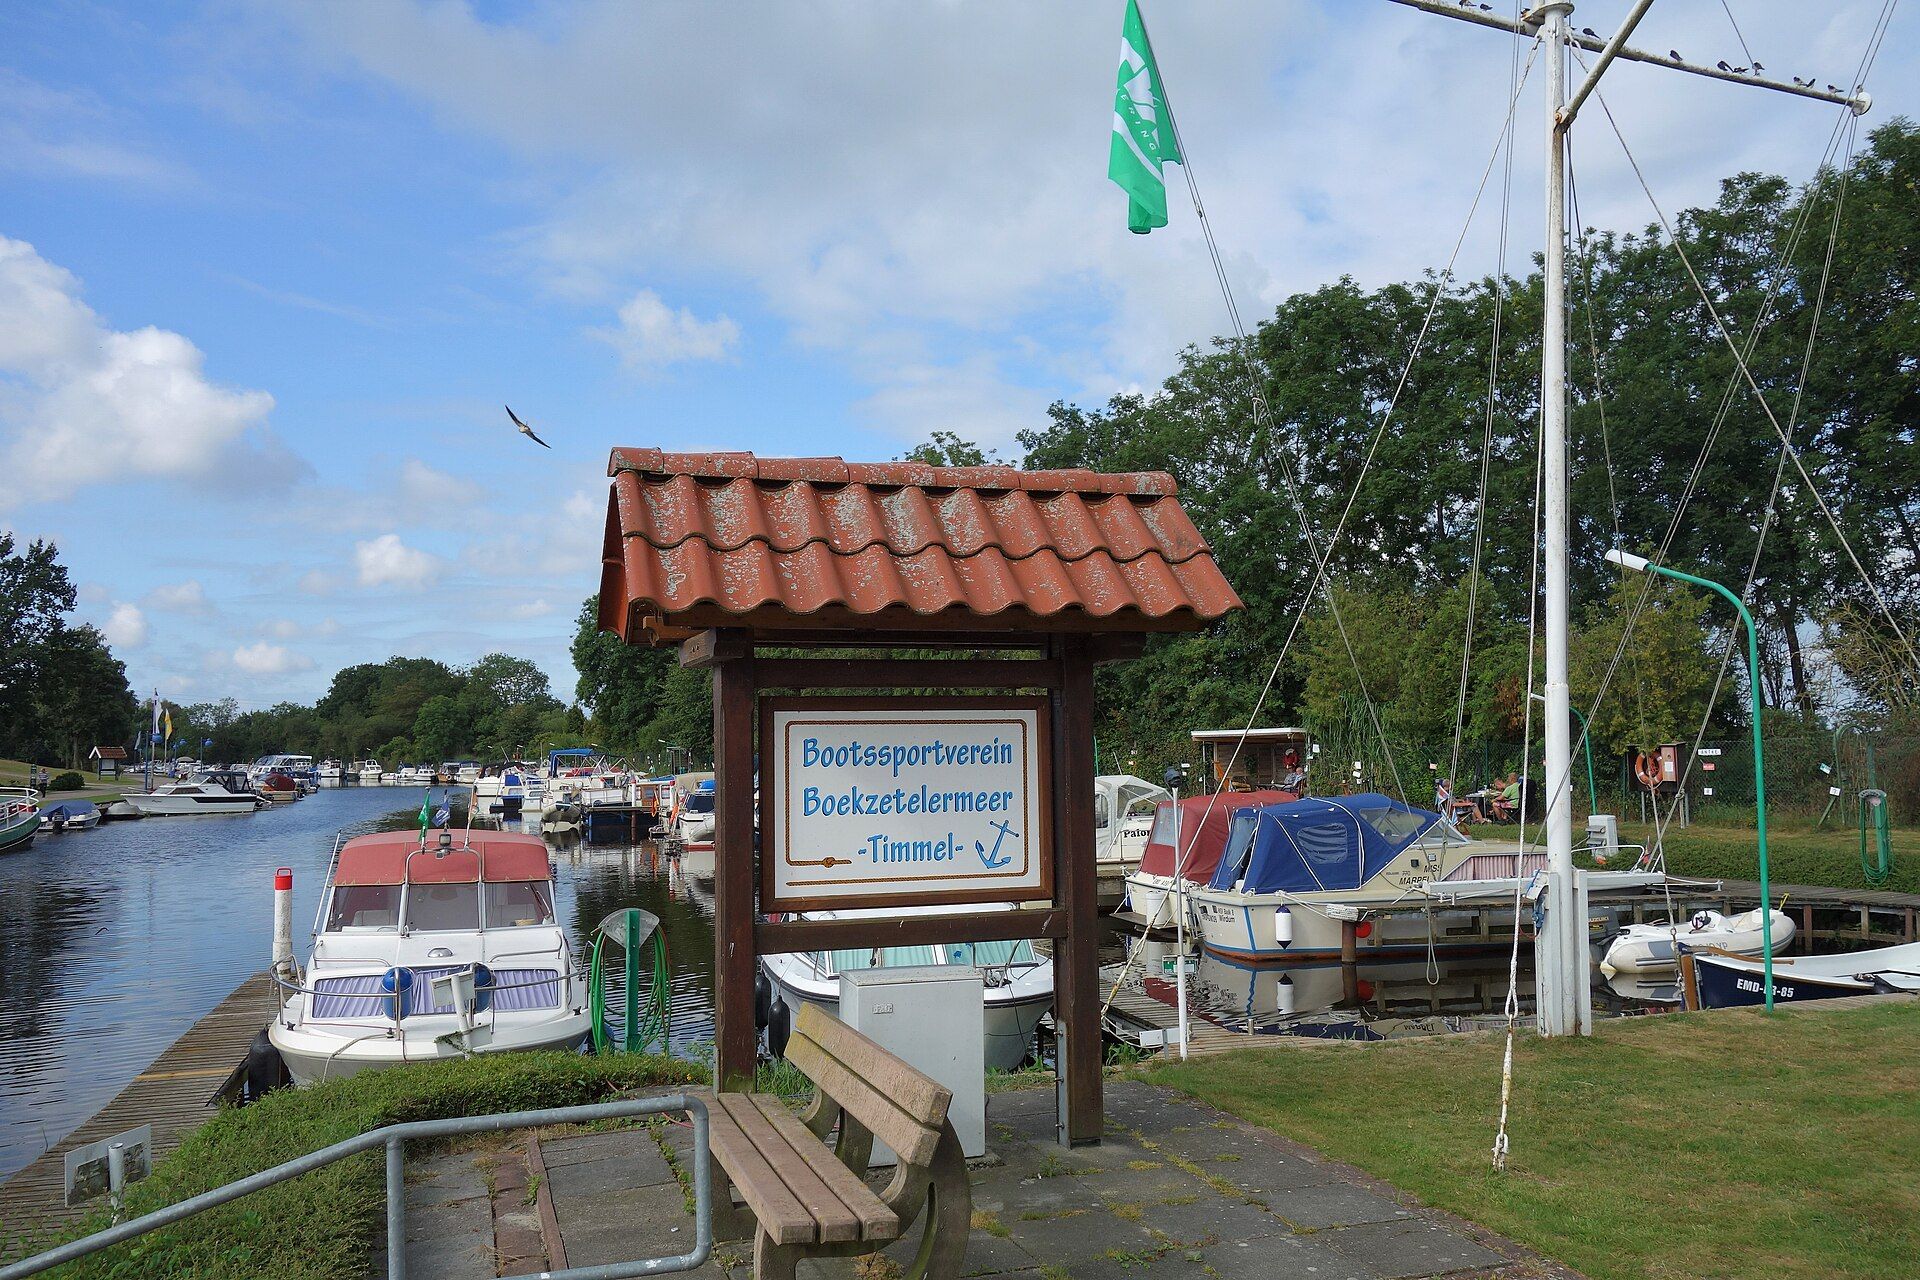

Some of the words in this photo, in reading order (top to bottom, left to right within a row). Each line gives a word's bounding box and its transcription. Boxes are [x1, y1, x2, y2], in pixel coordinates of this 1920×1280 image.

[803, 737, 1012, 777] Bootssportverein
[803, 784, 1013, 816] Boekzetelermeer
[858, 832, 963, 863] -Timmel-
